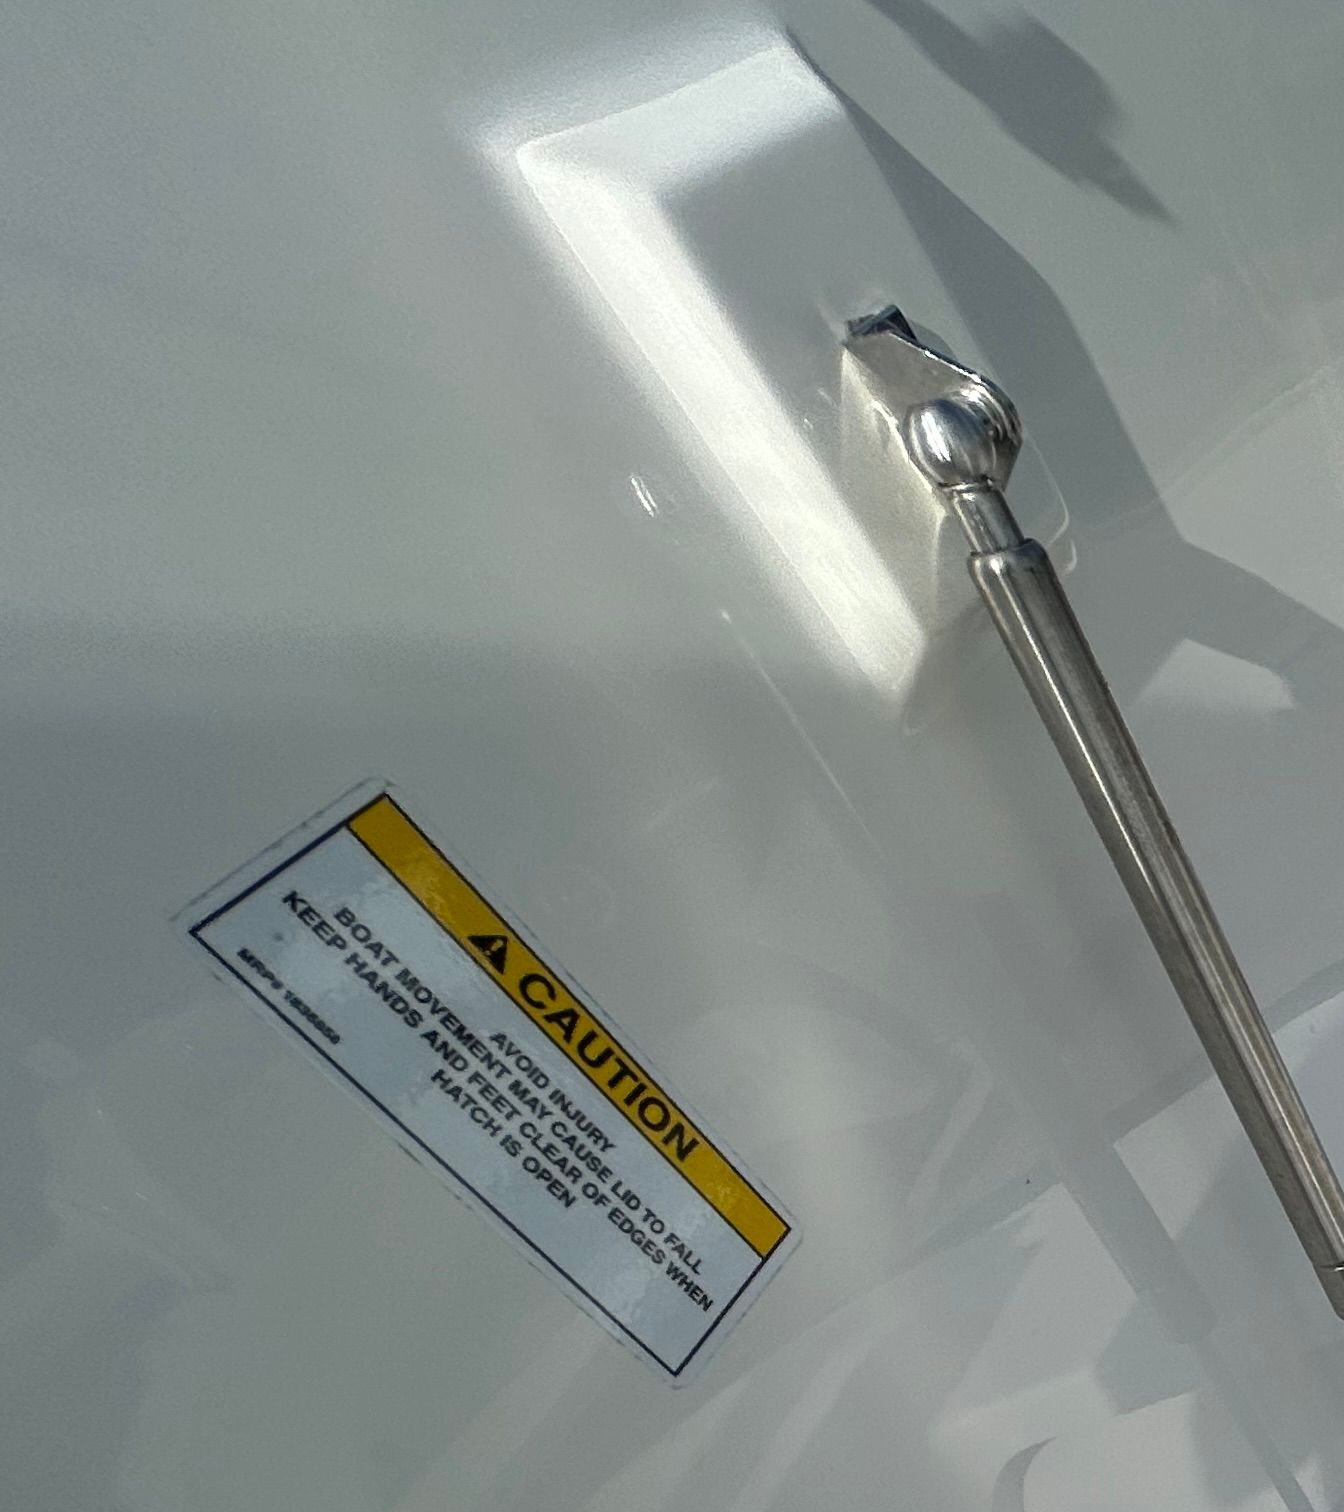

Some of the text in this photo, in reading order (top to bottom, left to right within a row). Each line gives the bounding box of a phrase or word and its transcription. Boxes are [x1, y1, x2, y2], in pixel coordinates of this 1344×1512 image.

[282, 890, 713, 1312] KEEP HANDS AND FEET CLEAR OF EDGES WHEN
[333, 907, 702, 1276] BOAT MOVEMENT MAY CAUSE LID TO FALL
[430, 1069, 578, 1208] HATCH IS OPEN
[490, 1032, 616, 1153] AVOID INJURY
[518, 971, 700, 1163] CAUTION
